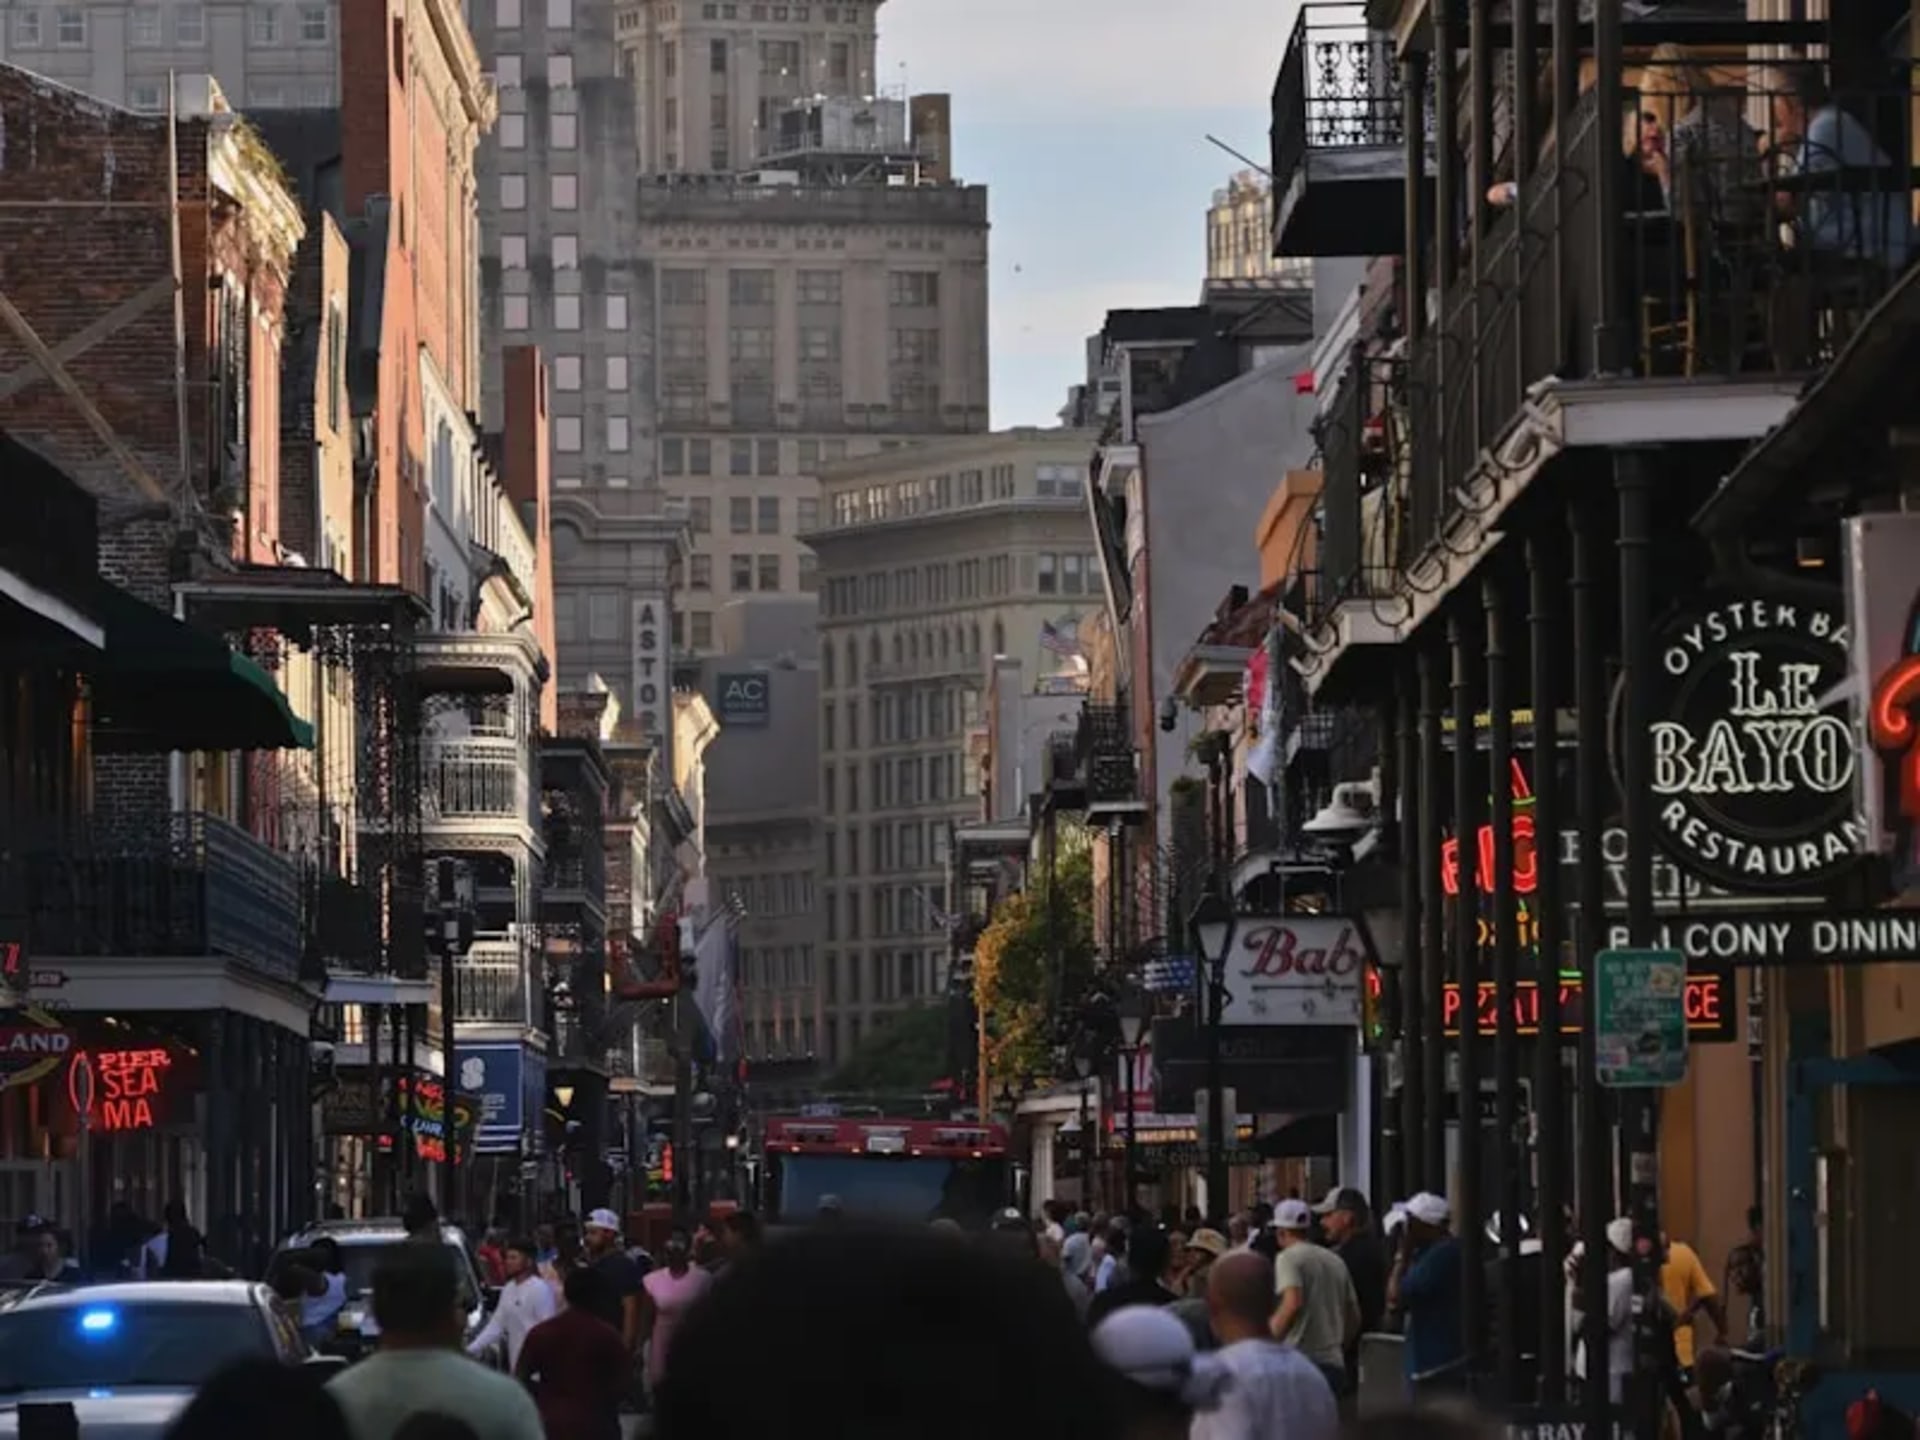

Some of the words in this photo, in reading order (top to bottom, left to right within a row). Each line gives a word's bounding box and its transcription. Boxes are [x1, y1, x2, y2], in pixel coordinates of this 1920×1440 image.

[1664, 600, 1796, 675] OYSTER
[724, 681, 763, 701] AC
[1728, 651, 1820, 716] LE
